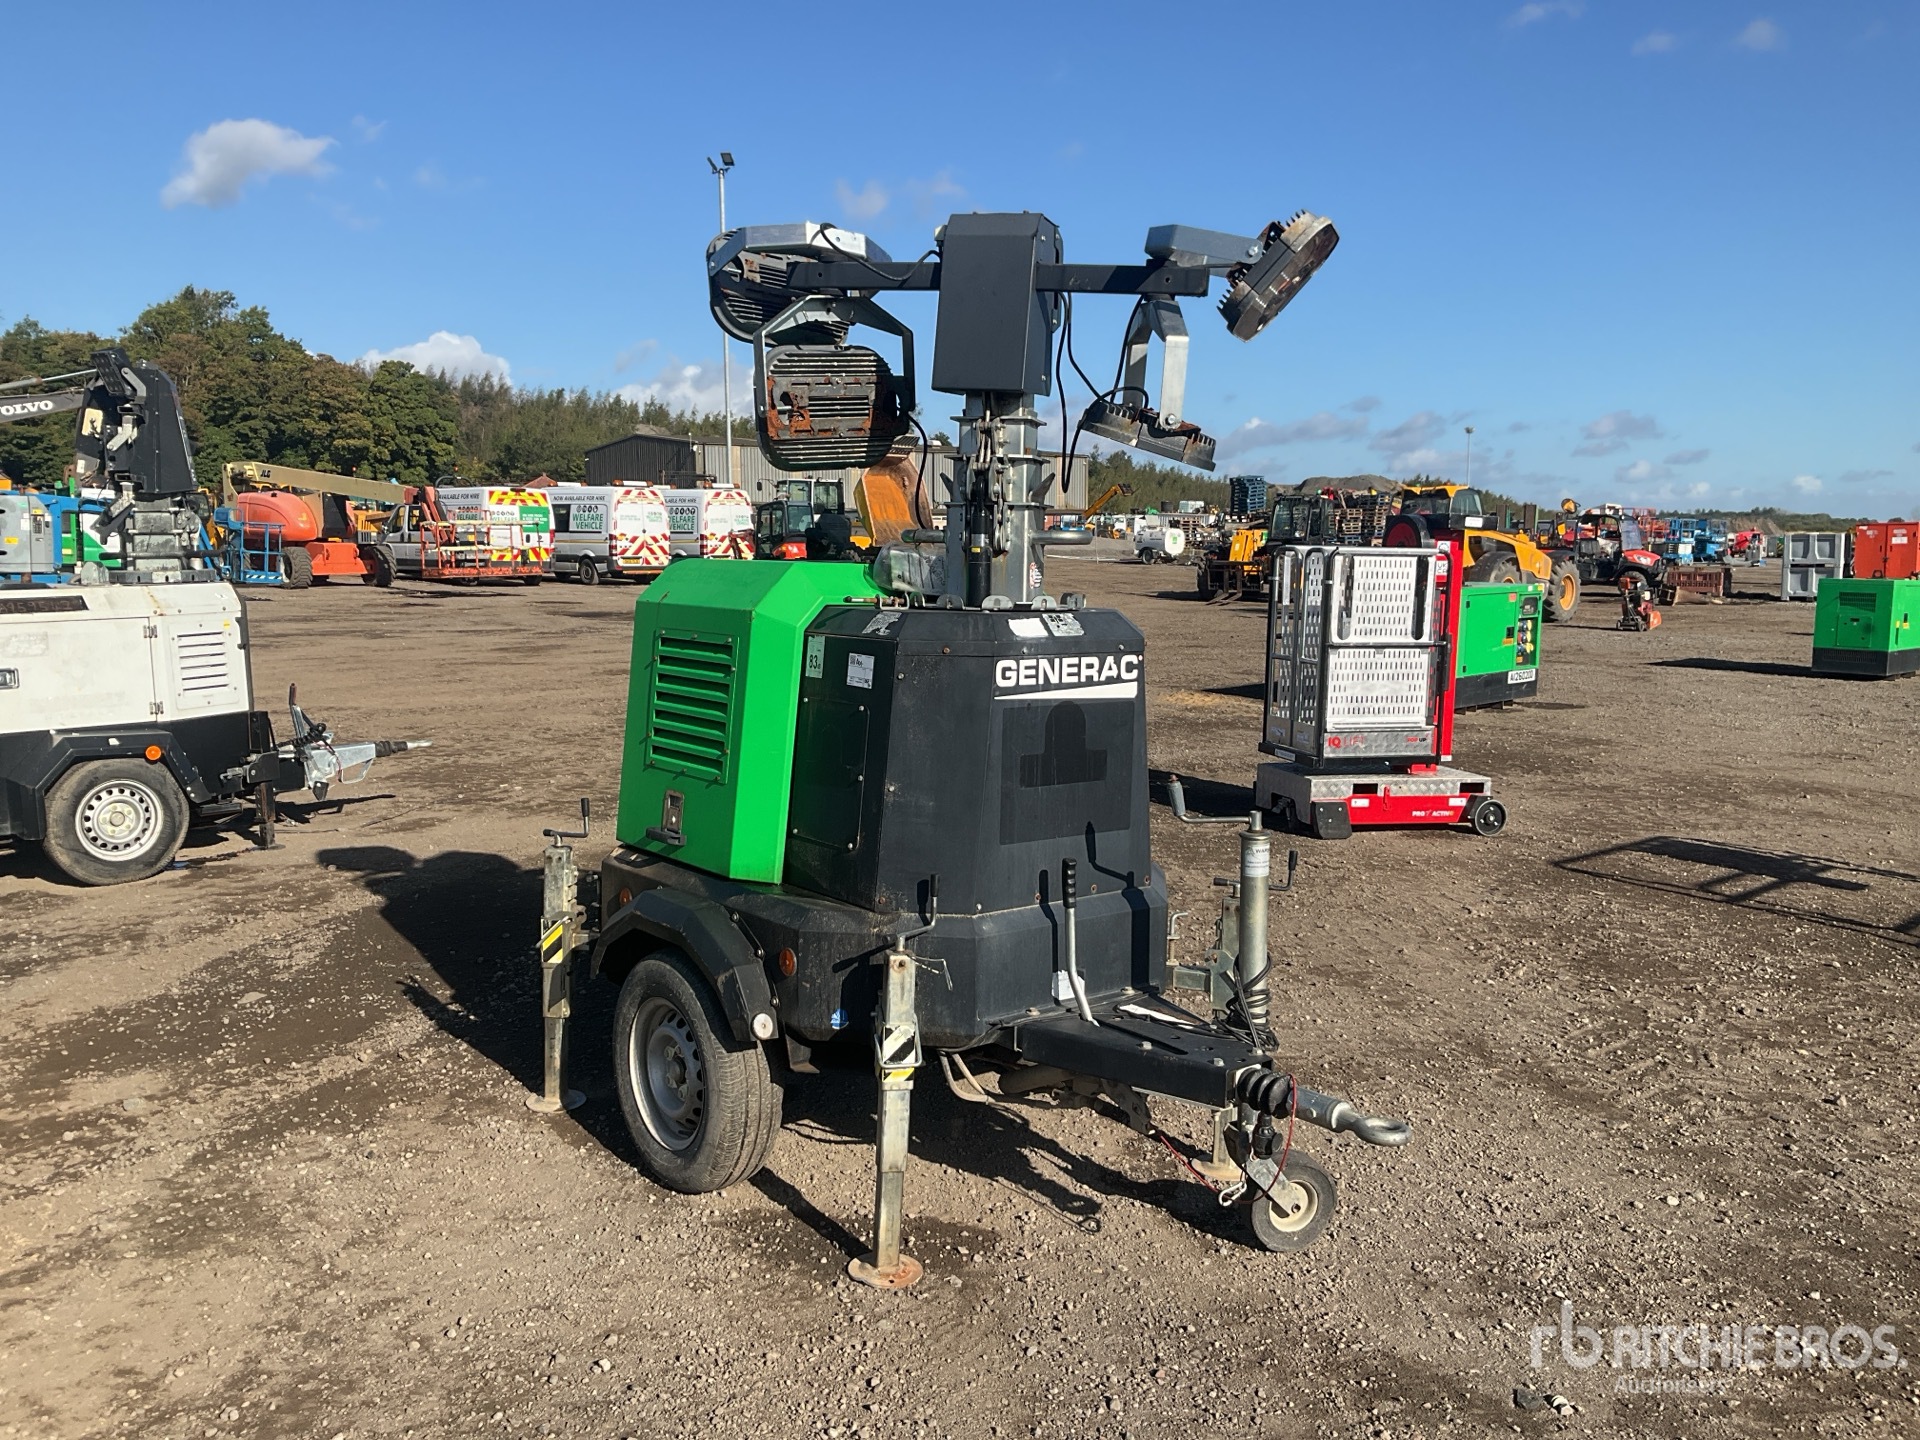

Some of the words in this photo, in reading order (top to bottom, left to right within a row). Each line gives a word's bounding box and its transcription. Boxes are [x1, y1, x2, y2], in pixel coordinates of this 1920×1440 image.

[0, 400, 53, 416] OLVO
[573, 513, 603, 521] WELFARE
[576, 522, 603, 530] VEHICLE
[809, 654, 818, 669] 83
[995, 655, 1138, 687] GENERAC
[1327, 736, 1341, 748] IQ
